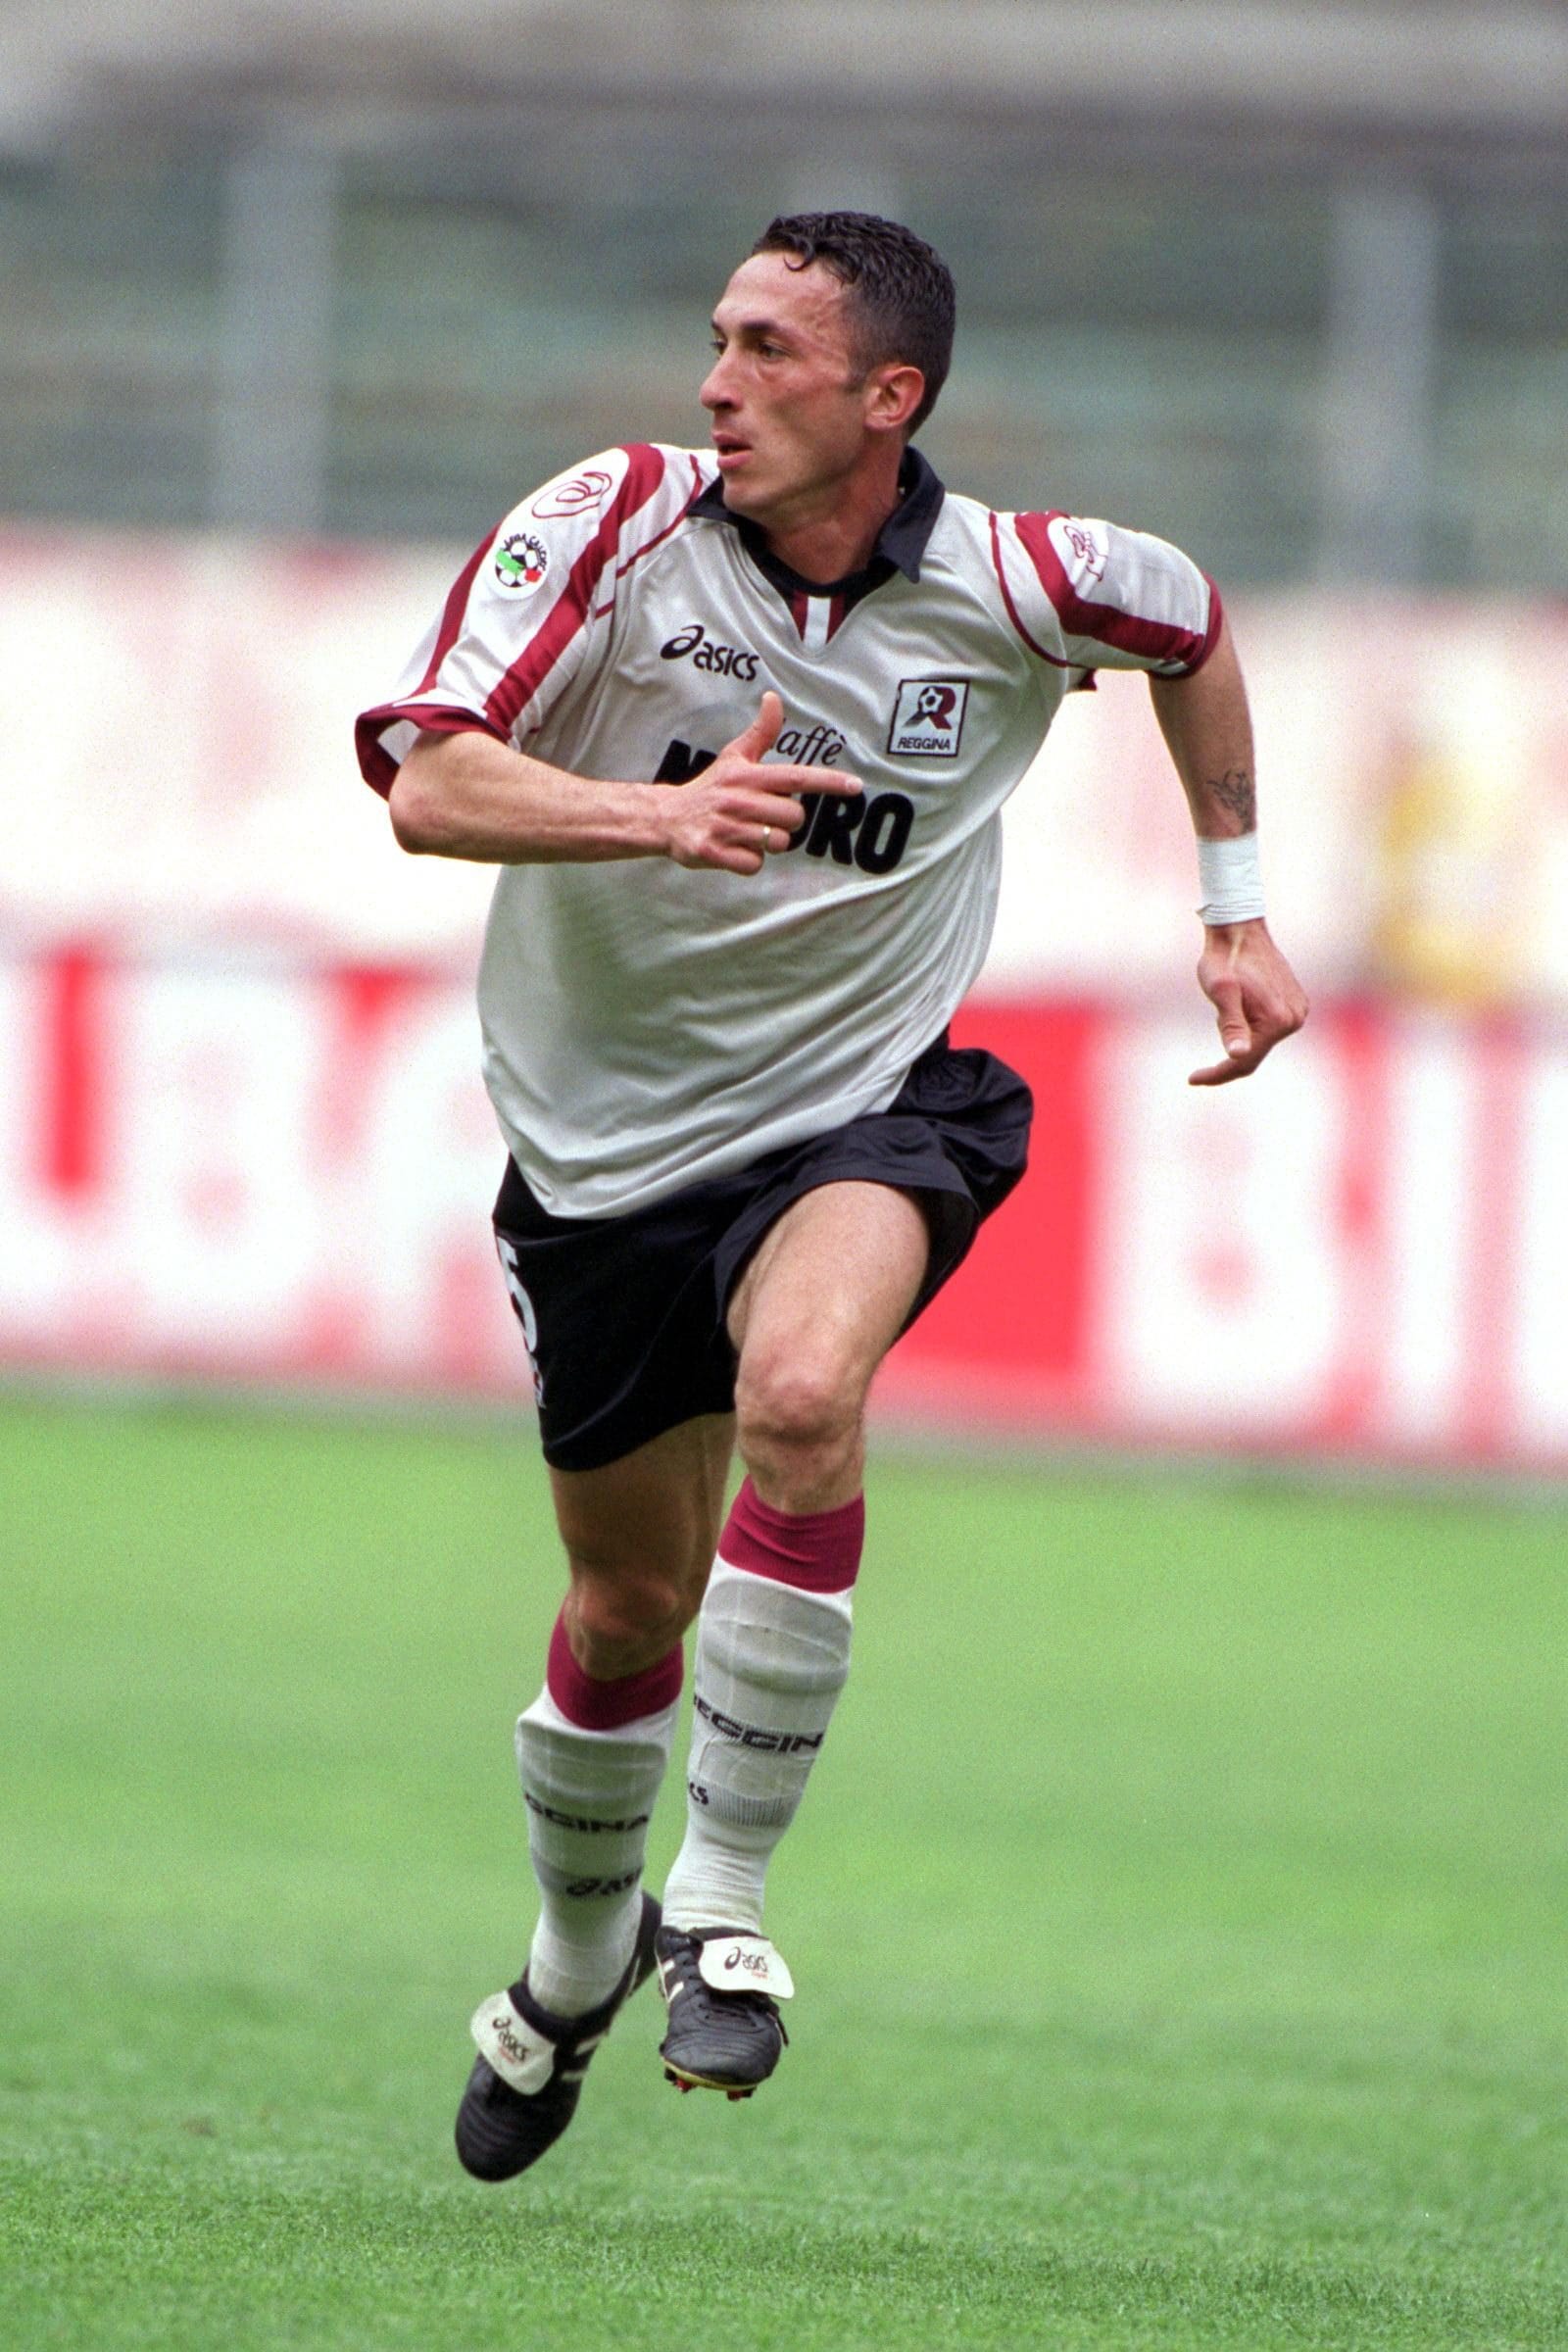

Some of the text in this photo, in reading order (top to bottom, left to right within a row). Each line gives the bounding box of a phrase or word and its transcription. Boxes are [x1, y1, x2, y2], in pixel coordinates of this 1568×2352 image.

[692, 640, 760, 681] asics
[775, 717, 847, 766] affè
[897, 736, 952, 751] REGGINA
